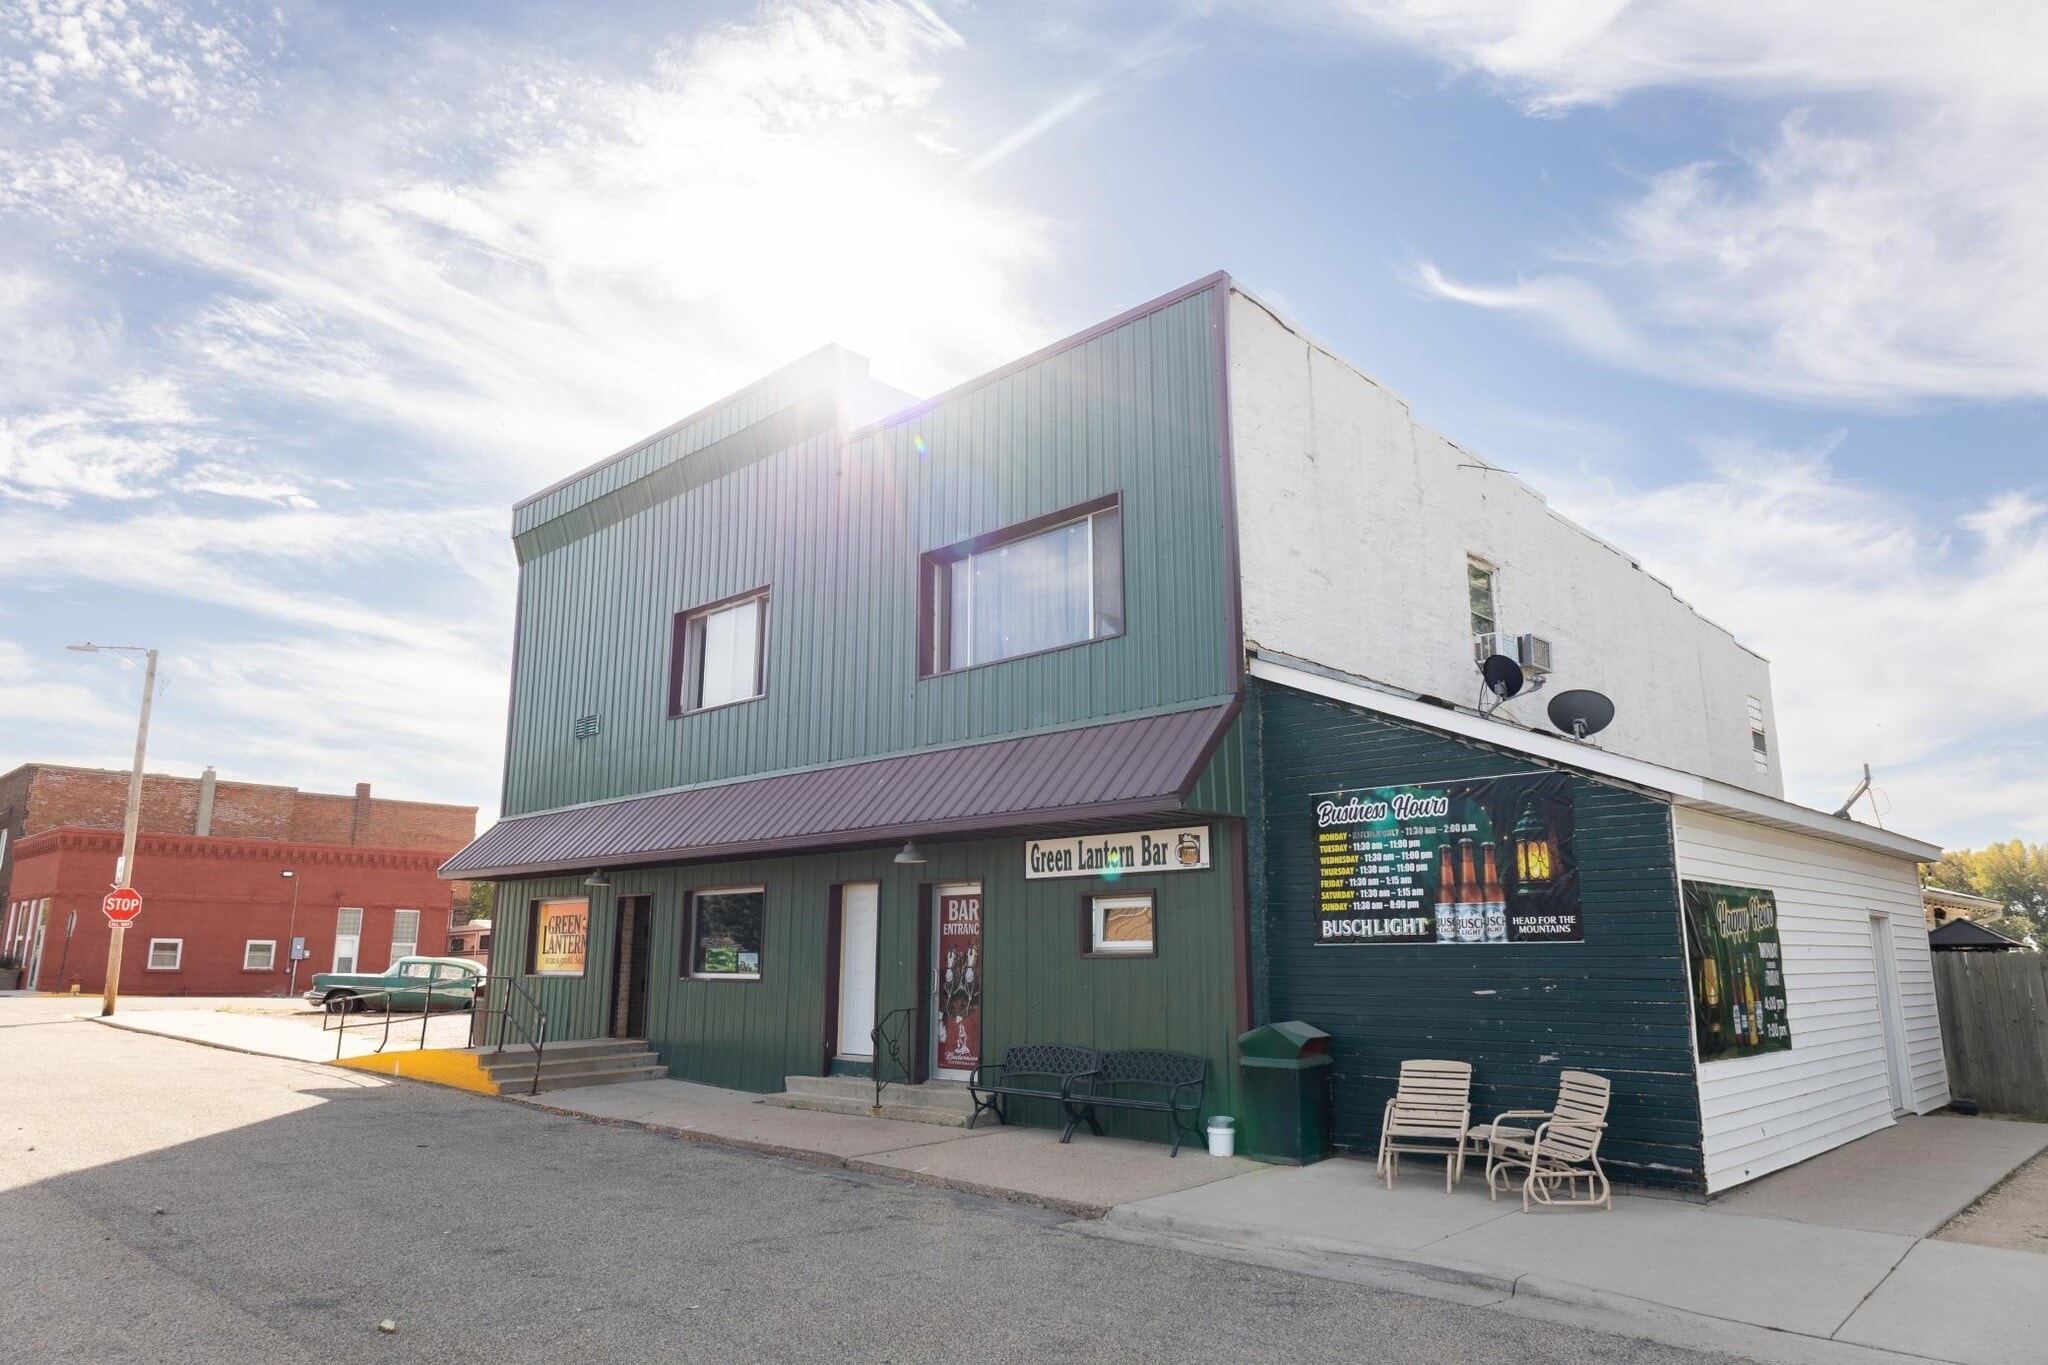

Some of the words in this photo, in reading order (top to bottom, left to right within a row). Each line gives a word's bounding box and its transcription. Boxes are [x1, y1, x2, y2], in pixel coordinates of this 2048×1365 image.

[1317, 797, 1388, 827] Business
[1393, 794, 1448, 820] Hours
[1319, 833, 1347, 841] MONDAY
[1425, 826, 1437, 834] am
[1320, 845, 1348, 853] TUESDAY
[1353, 842, 1370, 851] 11:30
[1371, 842, 1383, 850] am
[1408, 840, 1420, 849] pm
[1031, 843, 1072, 873] Green
[1078, 840, 1134, 870] Lantern
[1141, 835, 1168, 866] Bar
[1320, 855, 1359, 865] WEDNESDAY
[1364, 853, 1381, 862] 11:30
[1383, 853, 1394, 861] am
[1421, 851, 1433, 860] pm
[1320, 867, 1356, 876] THURSDAY
[1360, 865, 1377, 874] 11:30
[1378, 865, 1390, 873] am
[1416, 863, 1428, 872] pm
[1321, 879, 1344, 888] FRIDAY
[1349, 877, 1366, 887] 11:30
[1368, 878, 1379, 886] am
[1400, 876, 1412, 884] am
[1321, 891, 1355, 900] SATURDAY
[1360, 889, 1377, 898] 11:30
[1412, 888, 1424, 896] am
[106, 897, 139, 911] STOP
[948, 899, 979, 922] BAR
[1321, 903, 1348, 911] SUNDAY
[1353, 901, 1370, 910] 11:30
[1407, 900, 1419, 909] pm
[548, 914, 581, 934] GREEN
[1512, 916, 1537, 925] HEAD
[1539, 916, 1555, 925] FOR
[1557, 915, 1576, 924] THE
[1716, 900, 1749, 945] Happy
[1748, 895, 1774, 933] Hour
[1519, 924, 1571, 934] MOUNTAINS
[542, 925, 586, 955] LANTERN
